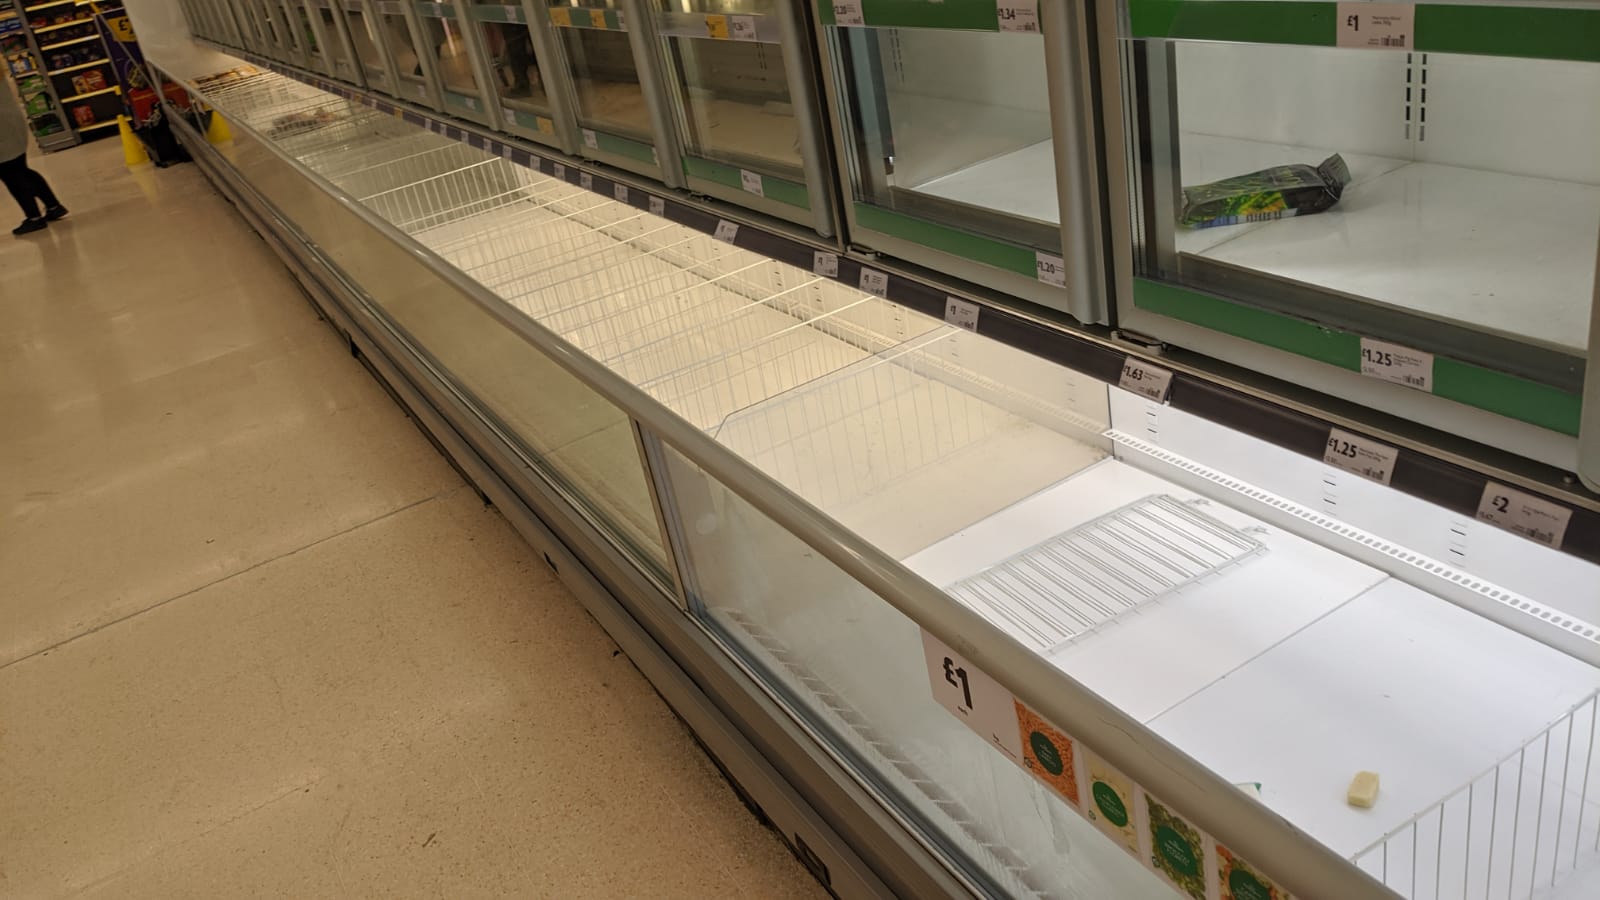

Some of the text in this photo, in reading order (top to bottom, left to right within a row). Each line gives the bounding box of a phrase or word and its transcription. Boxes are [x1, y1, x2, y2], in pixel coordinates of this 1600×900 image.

[1347, 15, 1359, 31] £1
[1362, 348, 1393, 367] £1.25
[1123, 365, 1144, 381] £1.63
[1328, 436, 1358, 459] £1.25
[1491, 495, 1510, 514] £2
[943, 656, 973, 711] £1
